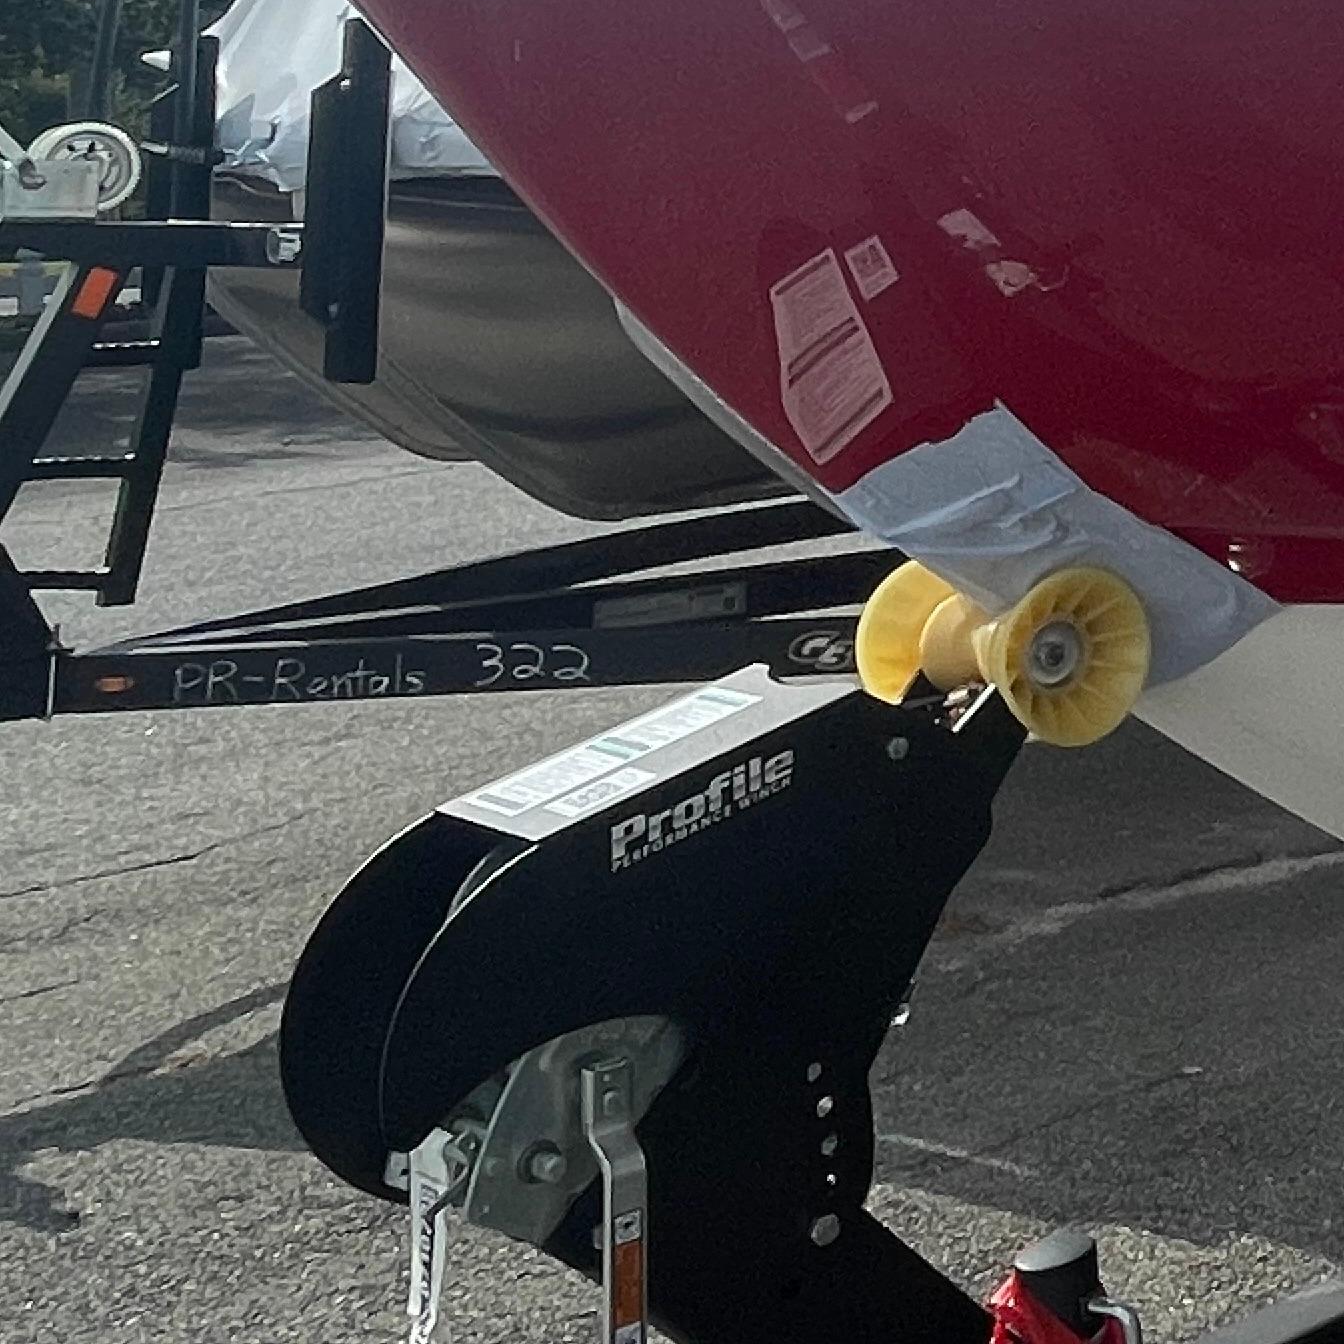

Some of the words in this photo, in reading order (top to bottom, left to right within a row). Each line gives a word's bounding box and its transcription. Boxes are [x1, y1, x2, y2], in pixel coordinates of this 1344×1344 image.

[173, 654, 427, 702] PR-Rentals
[475, 644, 590, 687] 322
[610, 749, 794, 861] Profile
